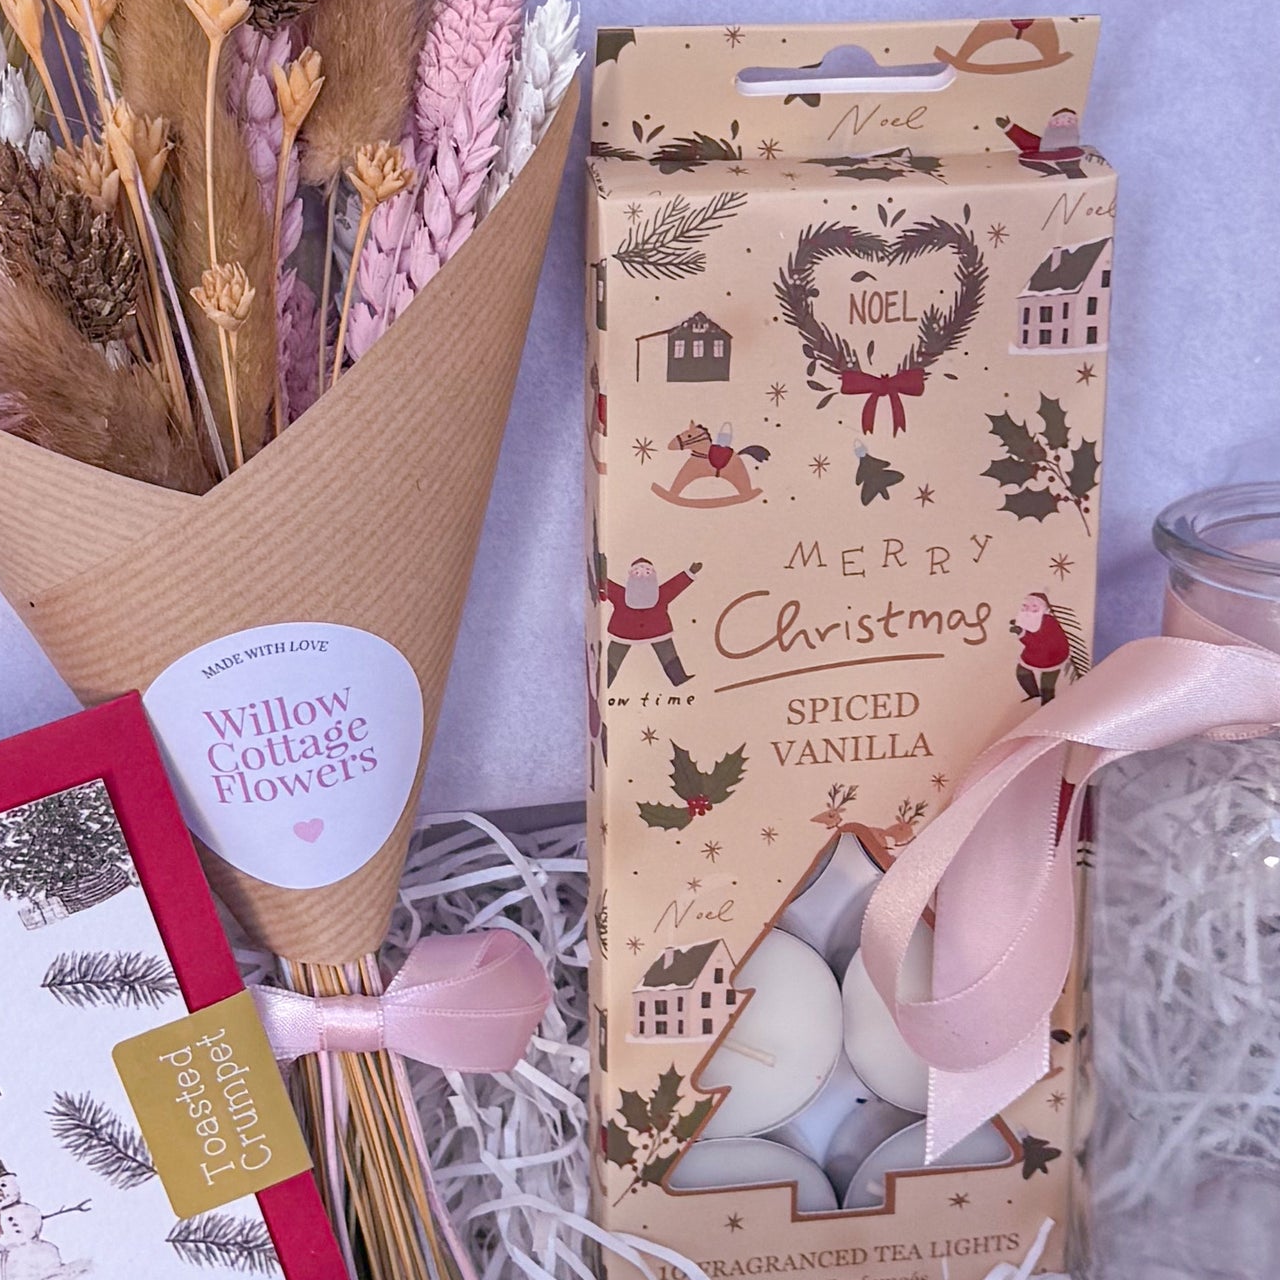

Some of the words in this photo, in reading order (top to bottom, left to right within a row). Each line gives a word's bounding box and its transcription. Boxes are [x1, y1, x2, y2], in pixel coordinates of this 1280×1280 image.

[827, 104, 928, 141] Noel
[849, 289, 918, 325] NOEL
[783, 534, 993, 578] MERRY
[714, 590, 992, 660] Christmas
[201, 653, 244, 680] MADE
[244, 642, 285, 661] WITH
[290, 639, 329, 653] LOVE
[202, 687, 351, 741] Willow
[640, 692, 695, 707] time
[786, 691, 920, 726] SPICED
[207, 716, 369, 773] Cottage
[770, 732, 935, 767] VANILLA
[210, 746, 378, 804] Flowers
[653, 899, 735, 934] Noel
[159, 1046, 236, 1186] Toasted
[196, 1028, 272, 1170] Crumpet
[696, 1247, 869, 1279] FRAGRANCED
[873, 1243, 923, 1264] TEA
[929, 1233, 1020, 1259] LIGHTS
